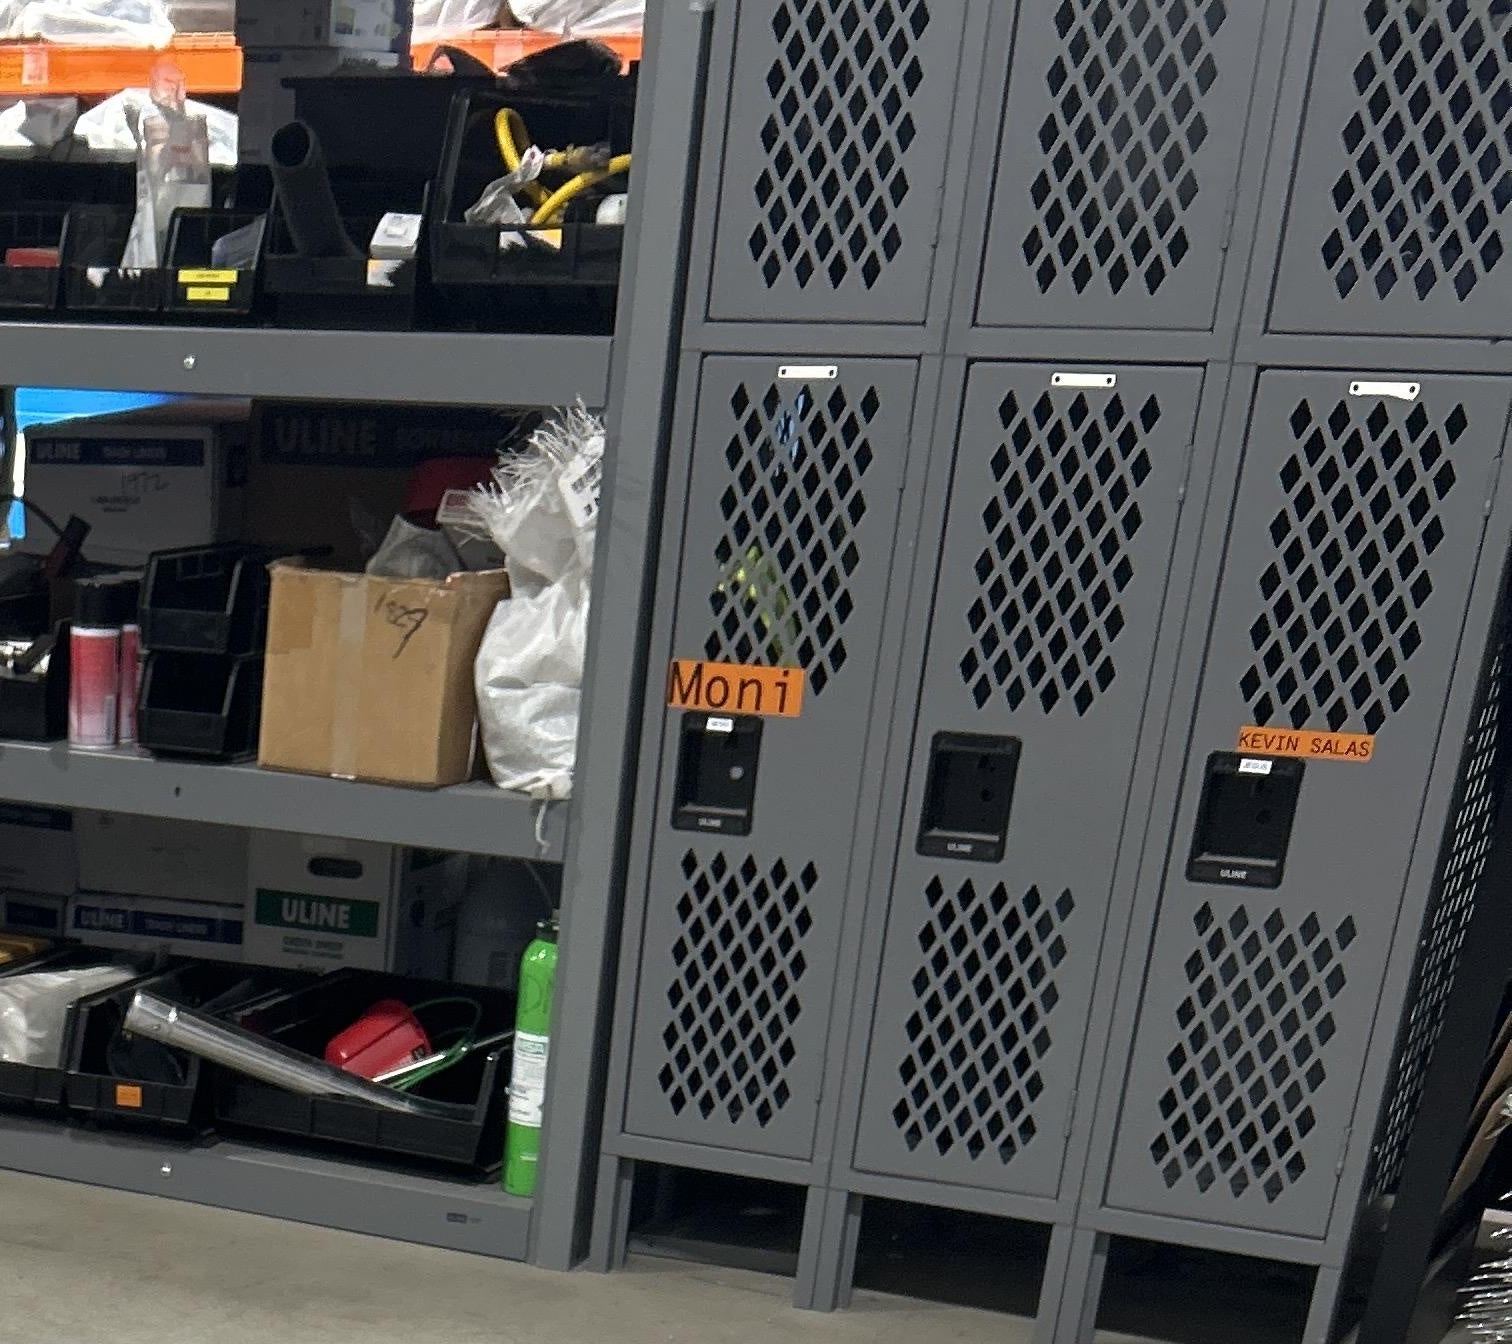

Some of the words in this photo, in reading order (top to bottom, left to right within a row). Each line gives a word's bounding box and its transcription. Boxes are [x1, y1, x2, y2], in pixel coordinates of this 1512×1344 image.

[668, 661, 790, 713] Moni
[1238, 731, 1301, 752] KEVIN
[1310, 737, 1370, 758] SALAS
[281, 898, 351, 929] ULINE
